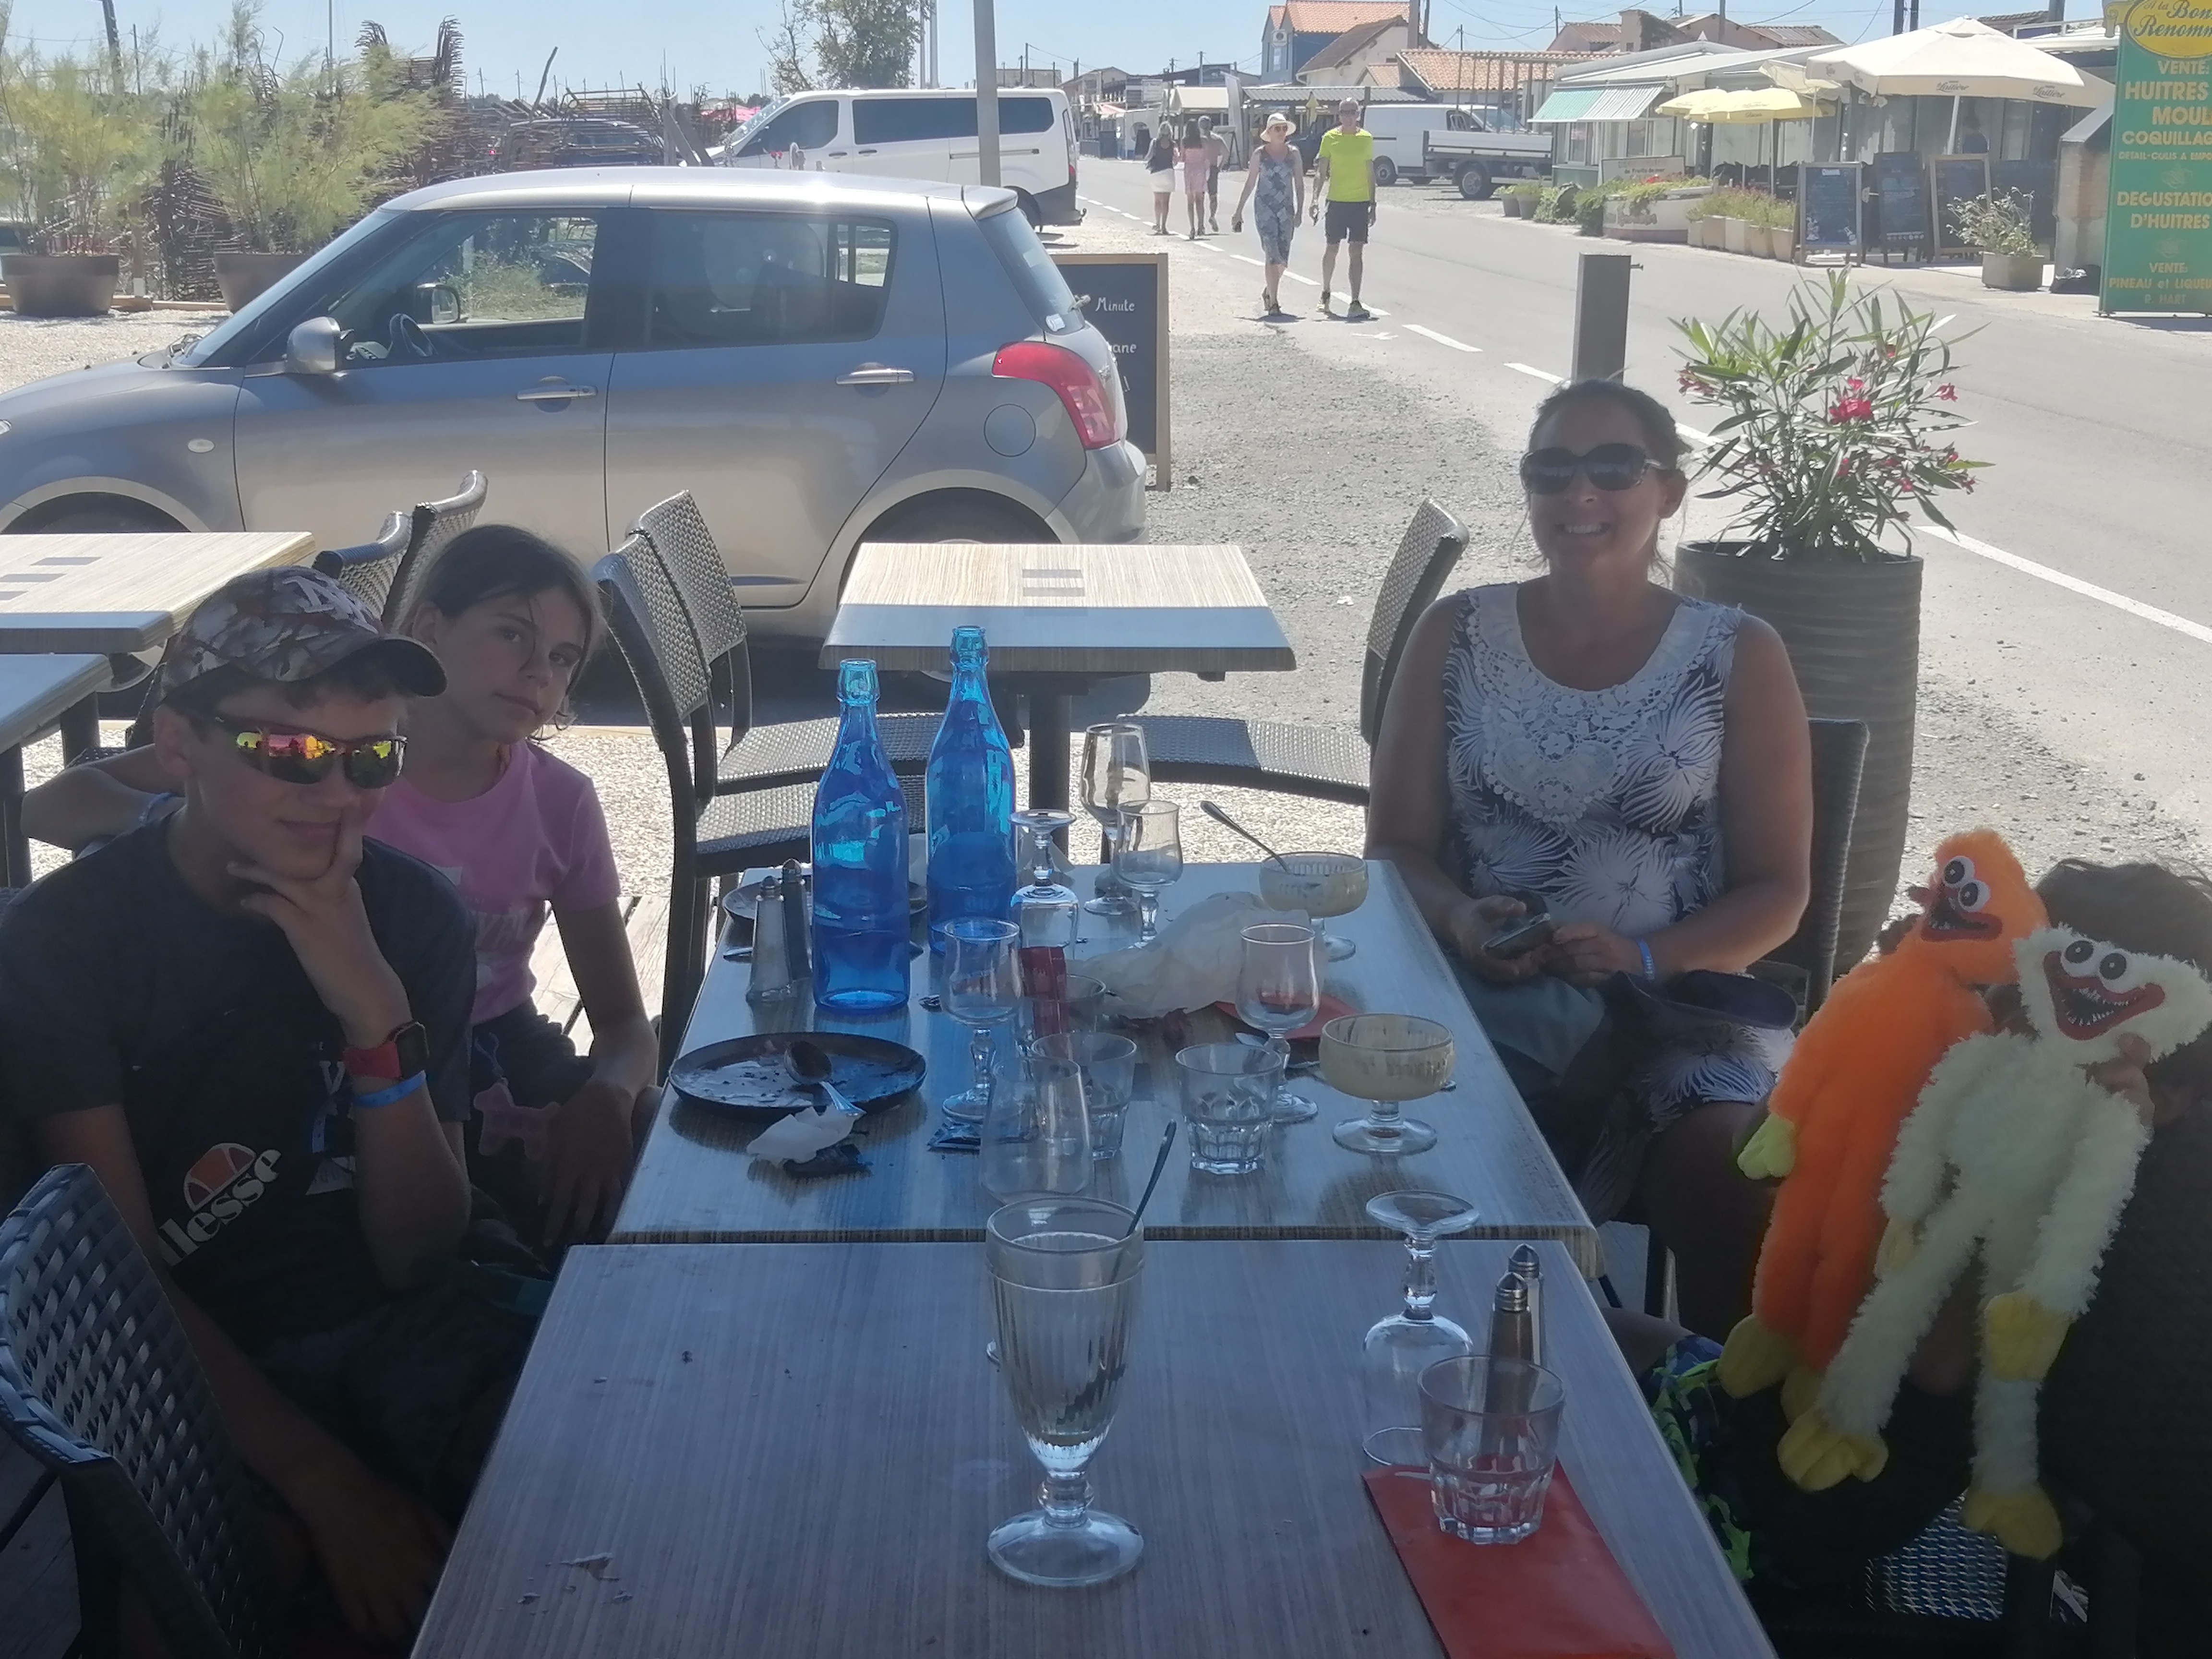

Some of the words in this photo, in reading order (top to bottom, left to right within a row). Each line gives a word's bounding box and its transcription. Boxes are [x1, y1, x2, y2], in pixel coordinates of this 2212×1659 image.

[2125, 81, 2209, 100] HUITRES
[2122, 131, 2212, 145] COQUILLAG
[2116, 192, 2212, 206] DEGUSTATIO
[2130, 214, 2210, 229] D'HUITRES
[2109, 277, 2152, 289] PINEAU
[1095, 297, 1135, 312] Minute
[1109, 343, 1137, 354] ane
[158, 1149, 282, 1267] llesse
